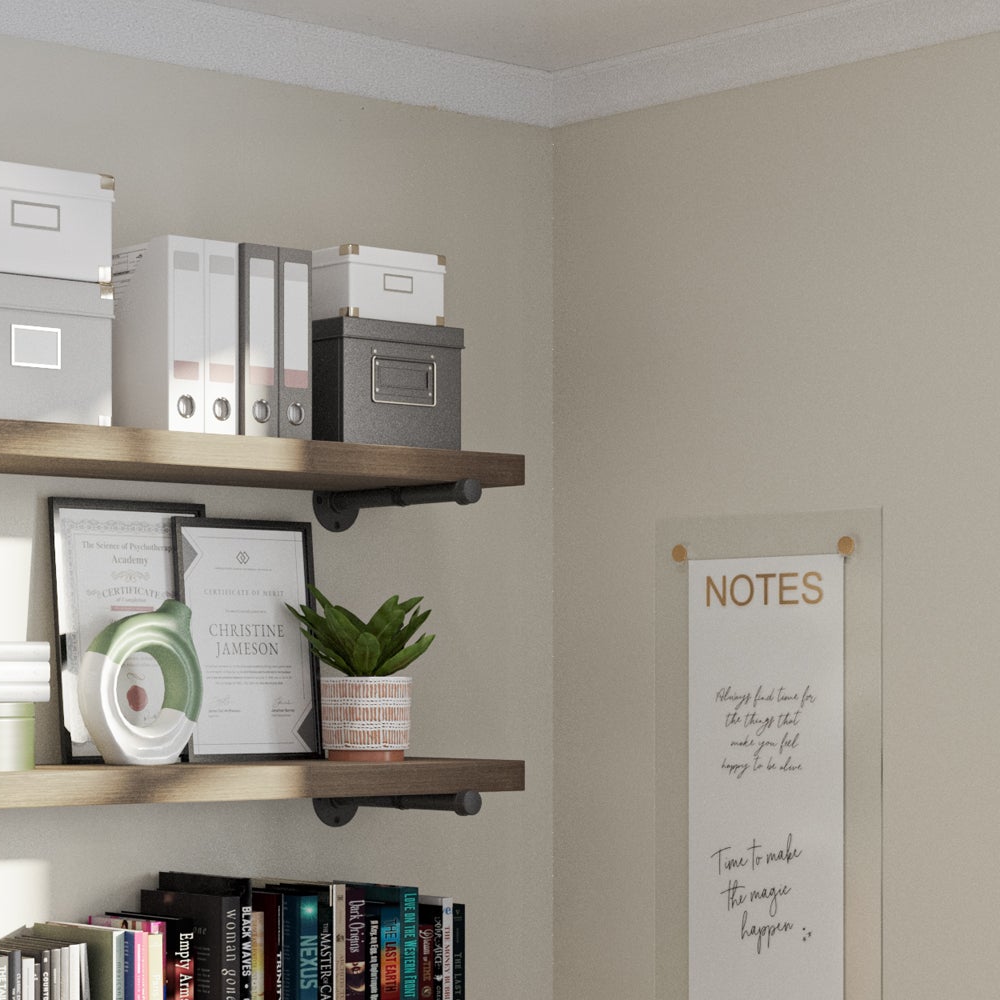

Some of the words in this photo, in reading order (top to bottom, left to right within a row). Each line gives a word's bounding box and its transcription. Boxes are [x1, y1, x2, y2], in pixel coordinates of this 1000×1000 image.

[82, 541, 95, 550] The
[96, 541, 119, 550] Science
[121, 542, 129, 550] of
[129, 543, 173, 553] Psychotherap
[112, 555, 149, 567] Academy
[102, 586, 160, 599] CERTIFICATE
[204, 588, 248, 596] CERTIFICATE
[706, 571, 824, 608] NOTES
[208, 623, 285, 638] CHRISTINE
[215, 641, 279, 658] JAMESON
[715, 686, 751, 711] Always
[753, 685, 774, 707] find
[777, 686, 799, 703] time
[801, 685, 816, 708] for
[725, 712, 742, 728] the
[744, 712, 775, 736] things
[777, 711, 801, 728] that
[730, 734, 754, 748] make
[757, 739, 777, 757] you
[779, 732, 800, 754] feel
[721, 757, 750, 779] happy
[752, 756, 763, 771] to
[766, 757, 777, 771] be
[779, 757, 803, 772] alive
[710, 846, 748, 876] Time
[747, 838, 762, 871] to
[766, 832, 803, 865] make
[348, 899, 365, 921] Dark
[403, 893, 417, 912] LOVE
[720, 879, 748, 912] the
[750, 883, 792, 918] magic
[242, 906, 251, 939] BLACK
[385, 918, 397, 939] THE
[404, 913, 415, 923] ON
[226, 909, 237, 962] woman
[347, 921, 365, 953] Origins
[404, 925, 415, 938] THE
[741, 910, 794, 955] happen
[175, 932, 194, 969] Empty
[242, 941, 251, 977] WAVES
[300, 935, 318, 990] NEXUS
[320, 932, 332, 977] MASTER
[385, 941, 397, 962] LAST
[403, 939, 417, 973] WESTERN
[454, 952, 463, 969] THE
[385, 965, 397, 992] EARTH
[403, 975, 417, 998] FRONT
[454, 973, 463, 995] LAST
